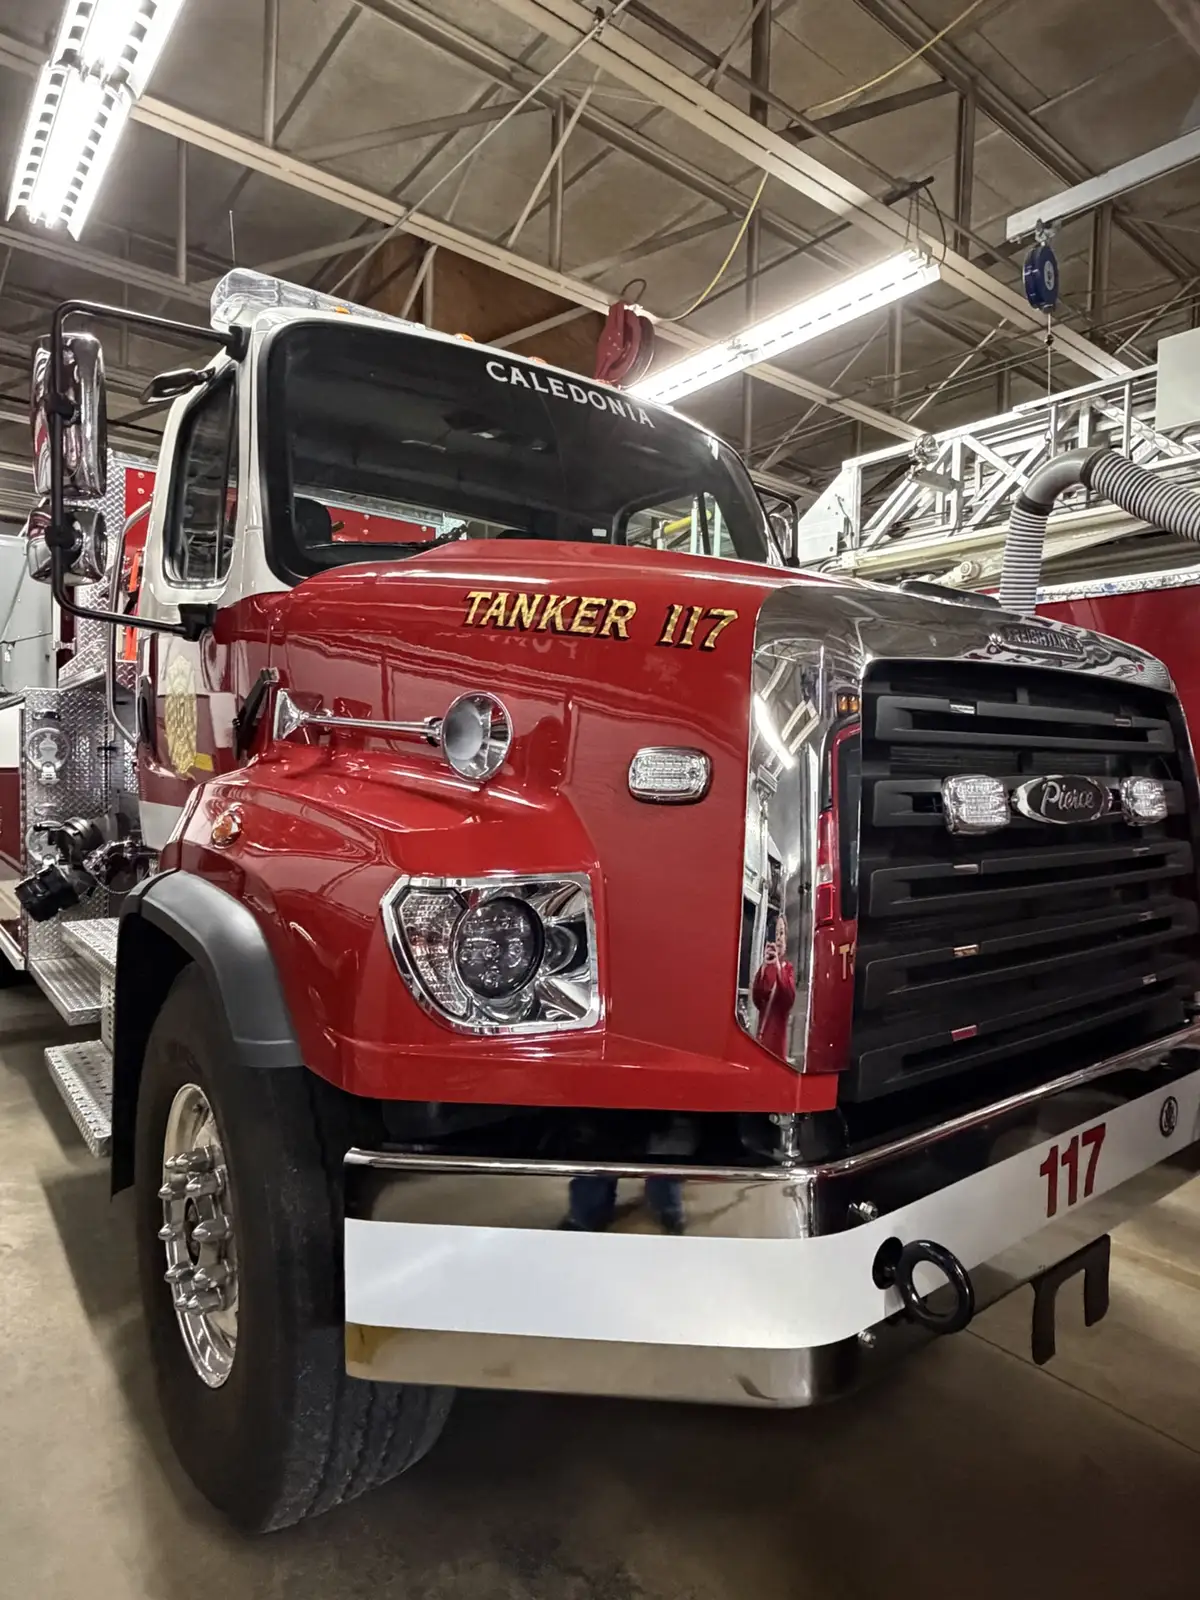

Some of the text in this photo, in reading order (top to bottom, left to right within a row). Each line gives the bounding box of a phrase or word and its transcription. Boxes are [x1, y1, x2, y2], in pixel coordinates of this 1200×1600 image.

[485, 360, 655, 429] CALEDONIA
[464, 591, 739, 651] TANKER 117
[1040, 780, 1095, 816] Pierce
[1039, 1122, 1106, 1218] 117
